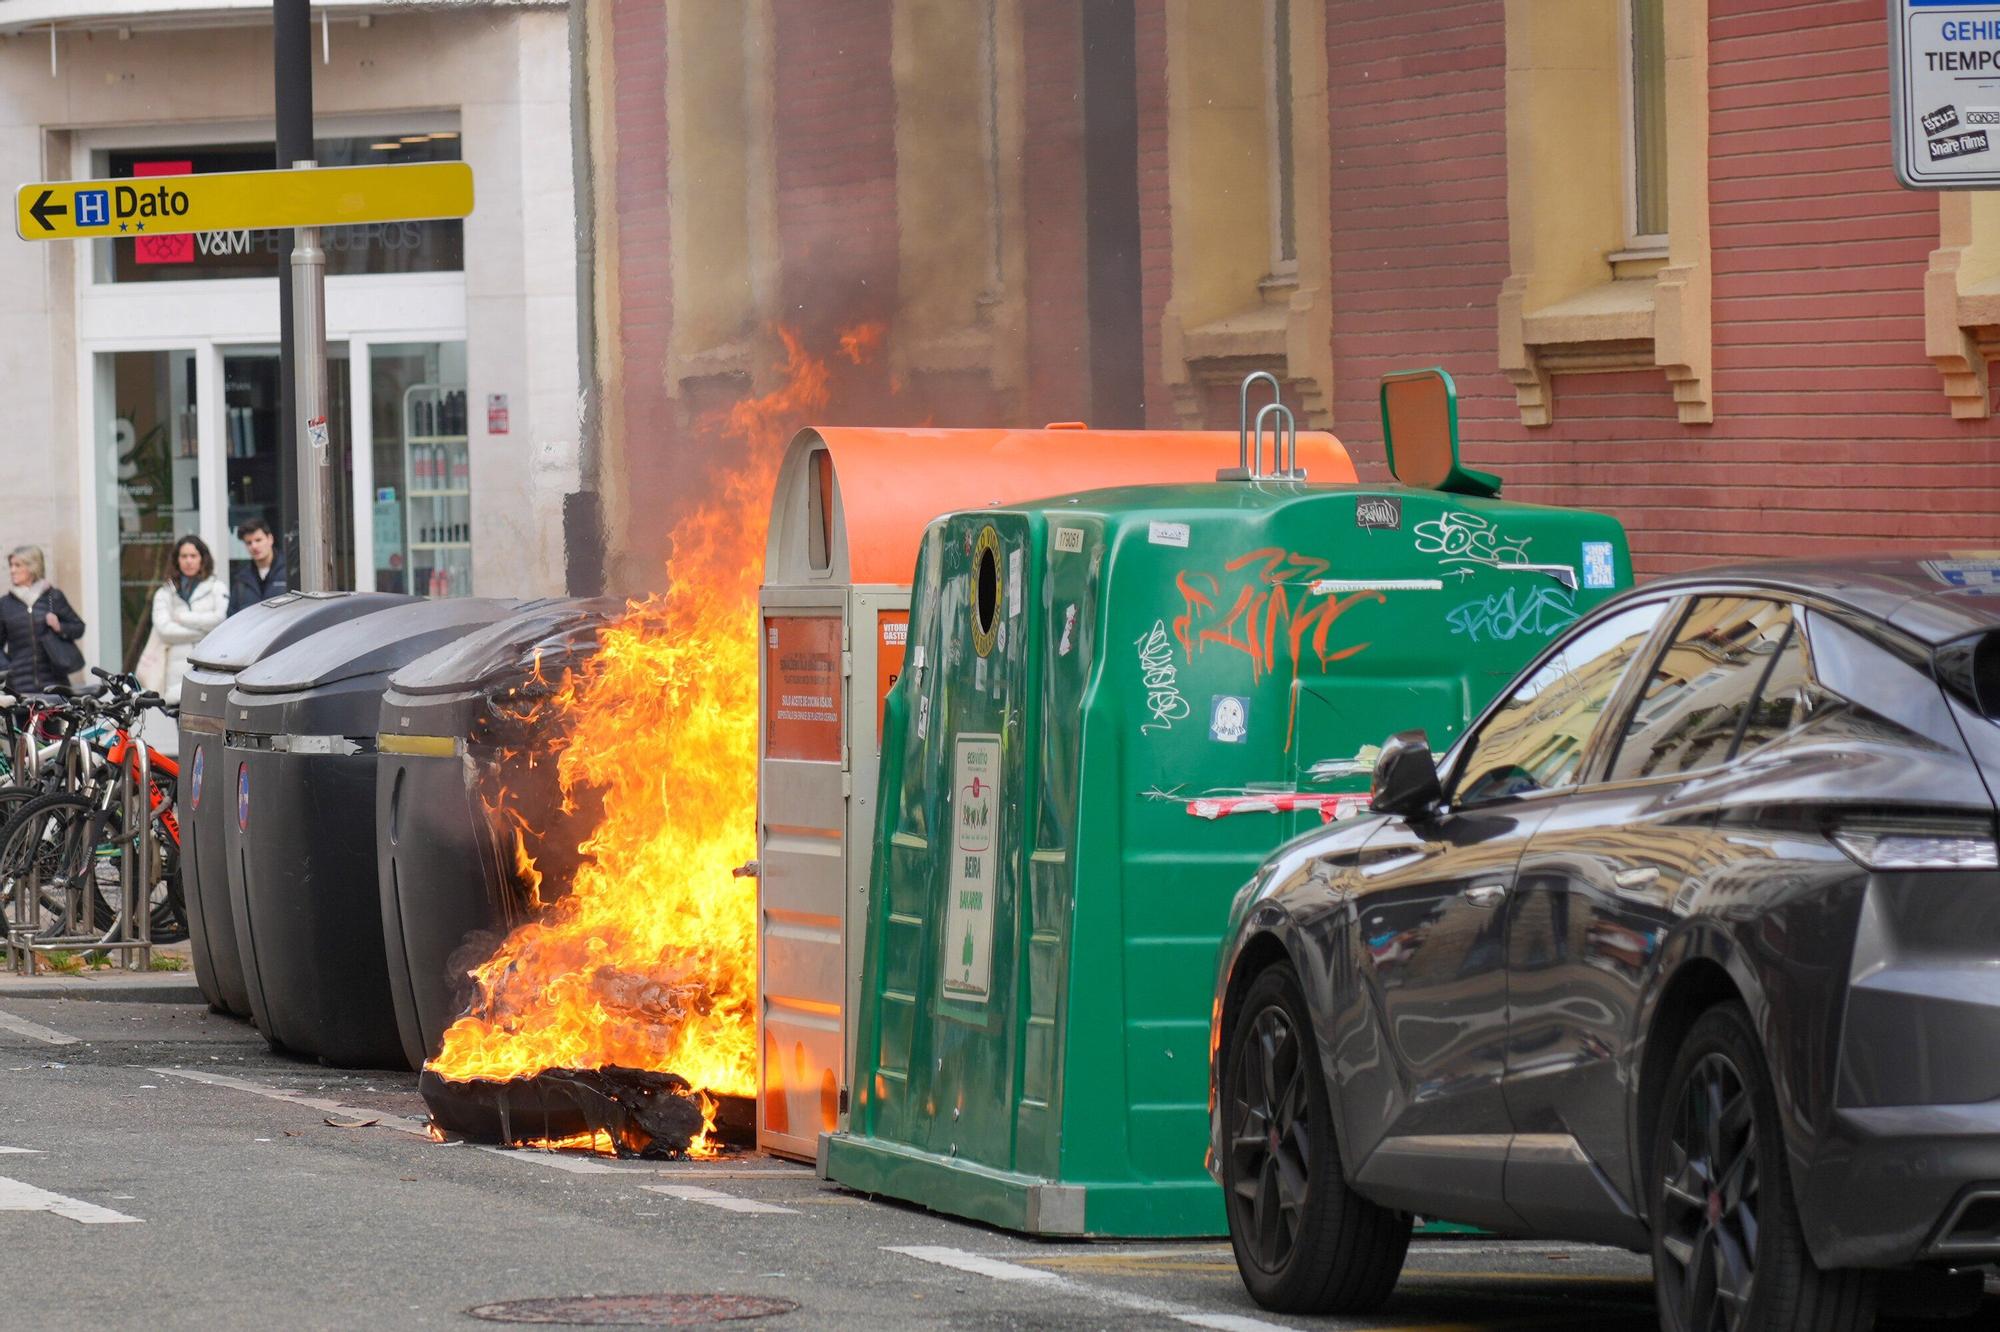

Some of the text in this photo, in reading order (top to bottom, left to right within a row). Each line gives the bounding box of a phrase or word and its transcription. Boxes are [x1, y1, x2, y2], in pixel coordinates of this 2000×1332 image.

[1930, 135, 1986, 156] Snare films
[115, 186, 189, 218] Dato
